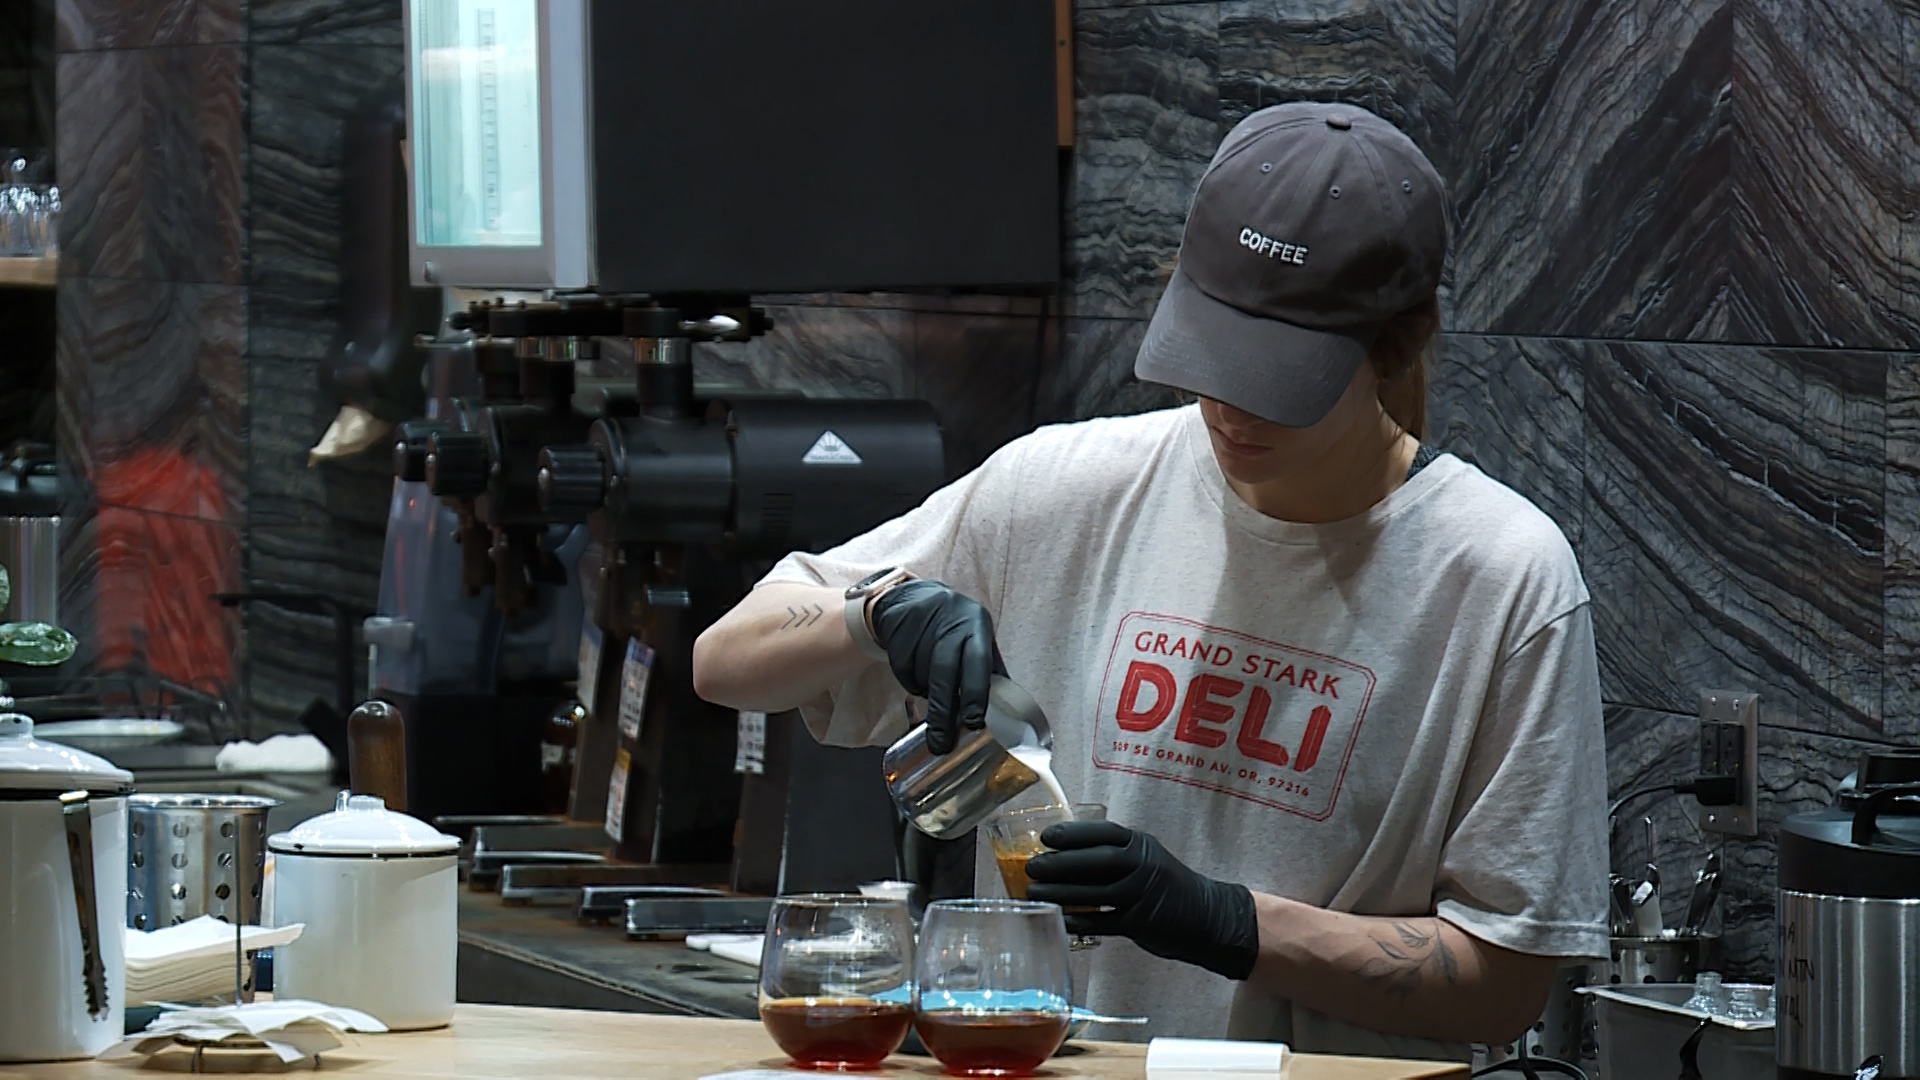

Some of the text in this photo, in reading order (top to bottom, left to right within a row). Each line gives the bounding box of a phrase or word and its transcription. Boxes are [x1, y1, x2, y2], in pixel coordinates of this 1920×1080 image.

[1240, 227, 1308, 264] COFFEE
[1135, 631, 1341, 699] GRAND STARK
[1116, 660, 1331, 772] DELI
[1134, 745, 1150, 756] SE
[1156, 749, 1205, 768] GRAND
